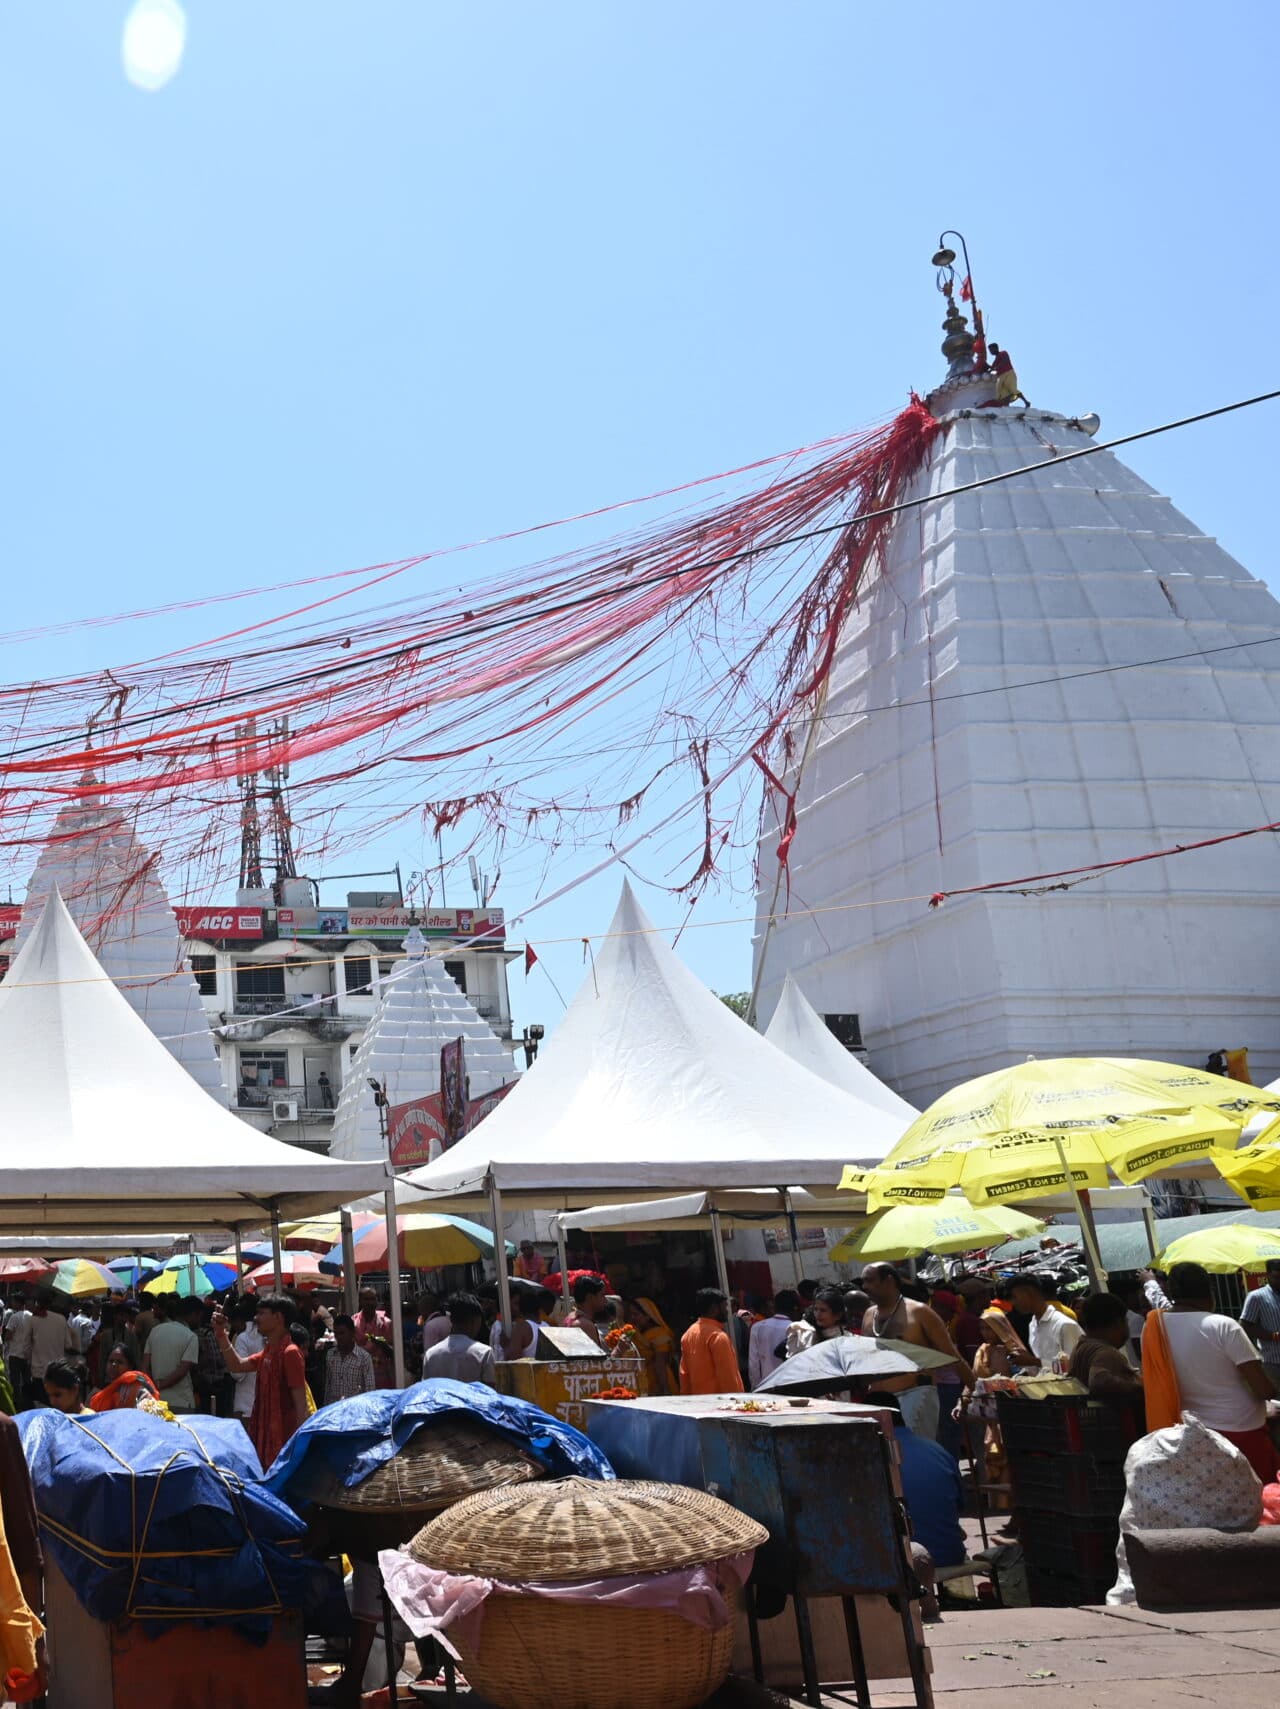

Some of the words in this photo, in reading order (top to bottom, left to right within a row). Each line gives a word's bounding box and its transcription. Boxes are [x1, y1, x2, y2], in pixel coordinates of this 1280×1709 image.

[196, 915, 233, 930] ACC
[350, 916, 364, 926] घर
[365, 915, 377, 927] को
[380, 915, 399, 926] पानी
[428, 915, 452, 927] शील्ड
